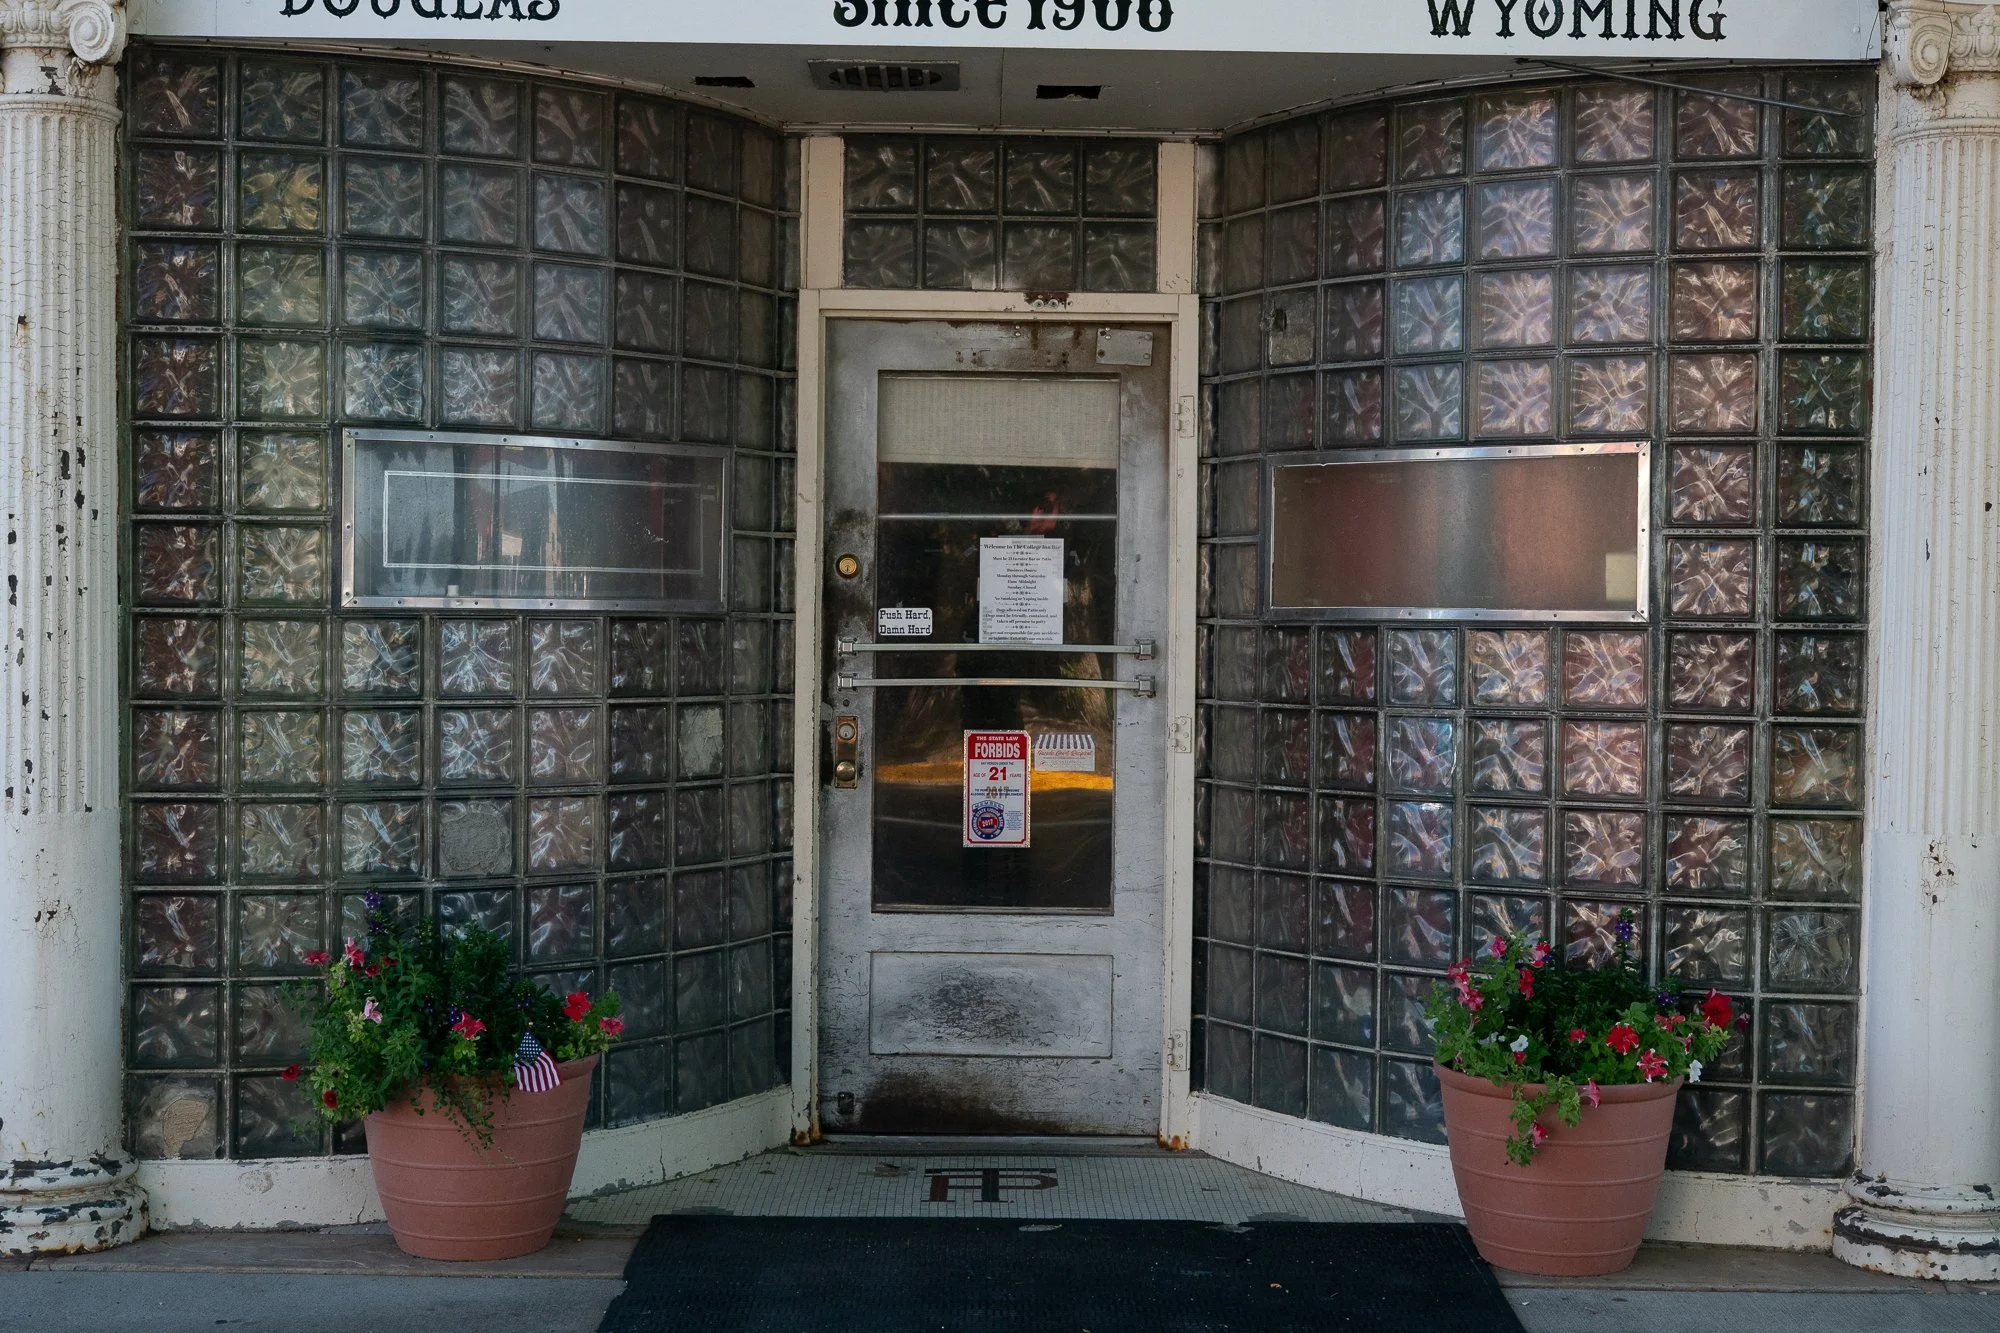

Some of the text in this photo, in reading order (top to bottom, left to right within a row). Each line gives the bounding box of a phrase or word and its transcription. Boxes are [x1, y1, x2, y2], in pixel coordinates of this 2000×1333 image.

[1428, 0, 1728, 41] WYOMING
[880, 610, 931, 620] Push Hard,
[880, 625, 931, 634] Damn Hard
[974, 742, 1020, 758] FORBIDS
[988, 766, 1007, 781] 21
[981, 819, 994, 827] 2017
